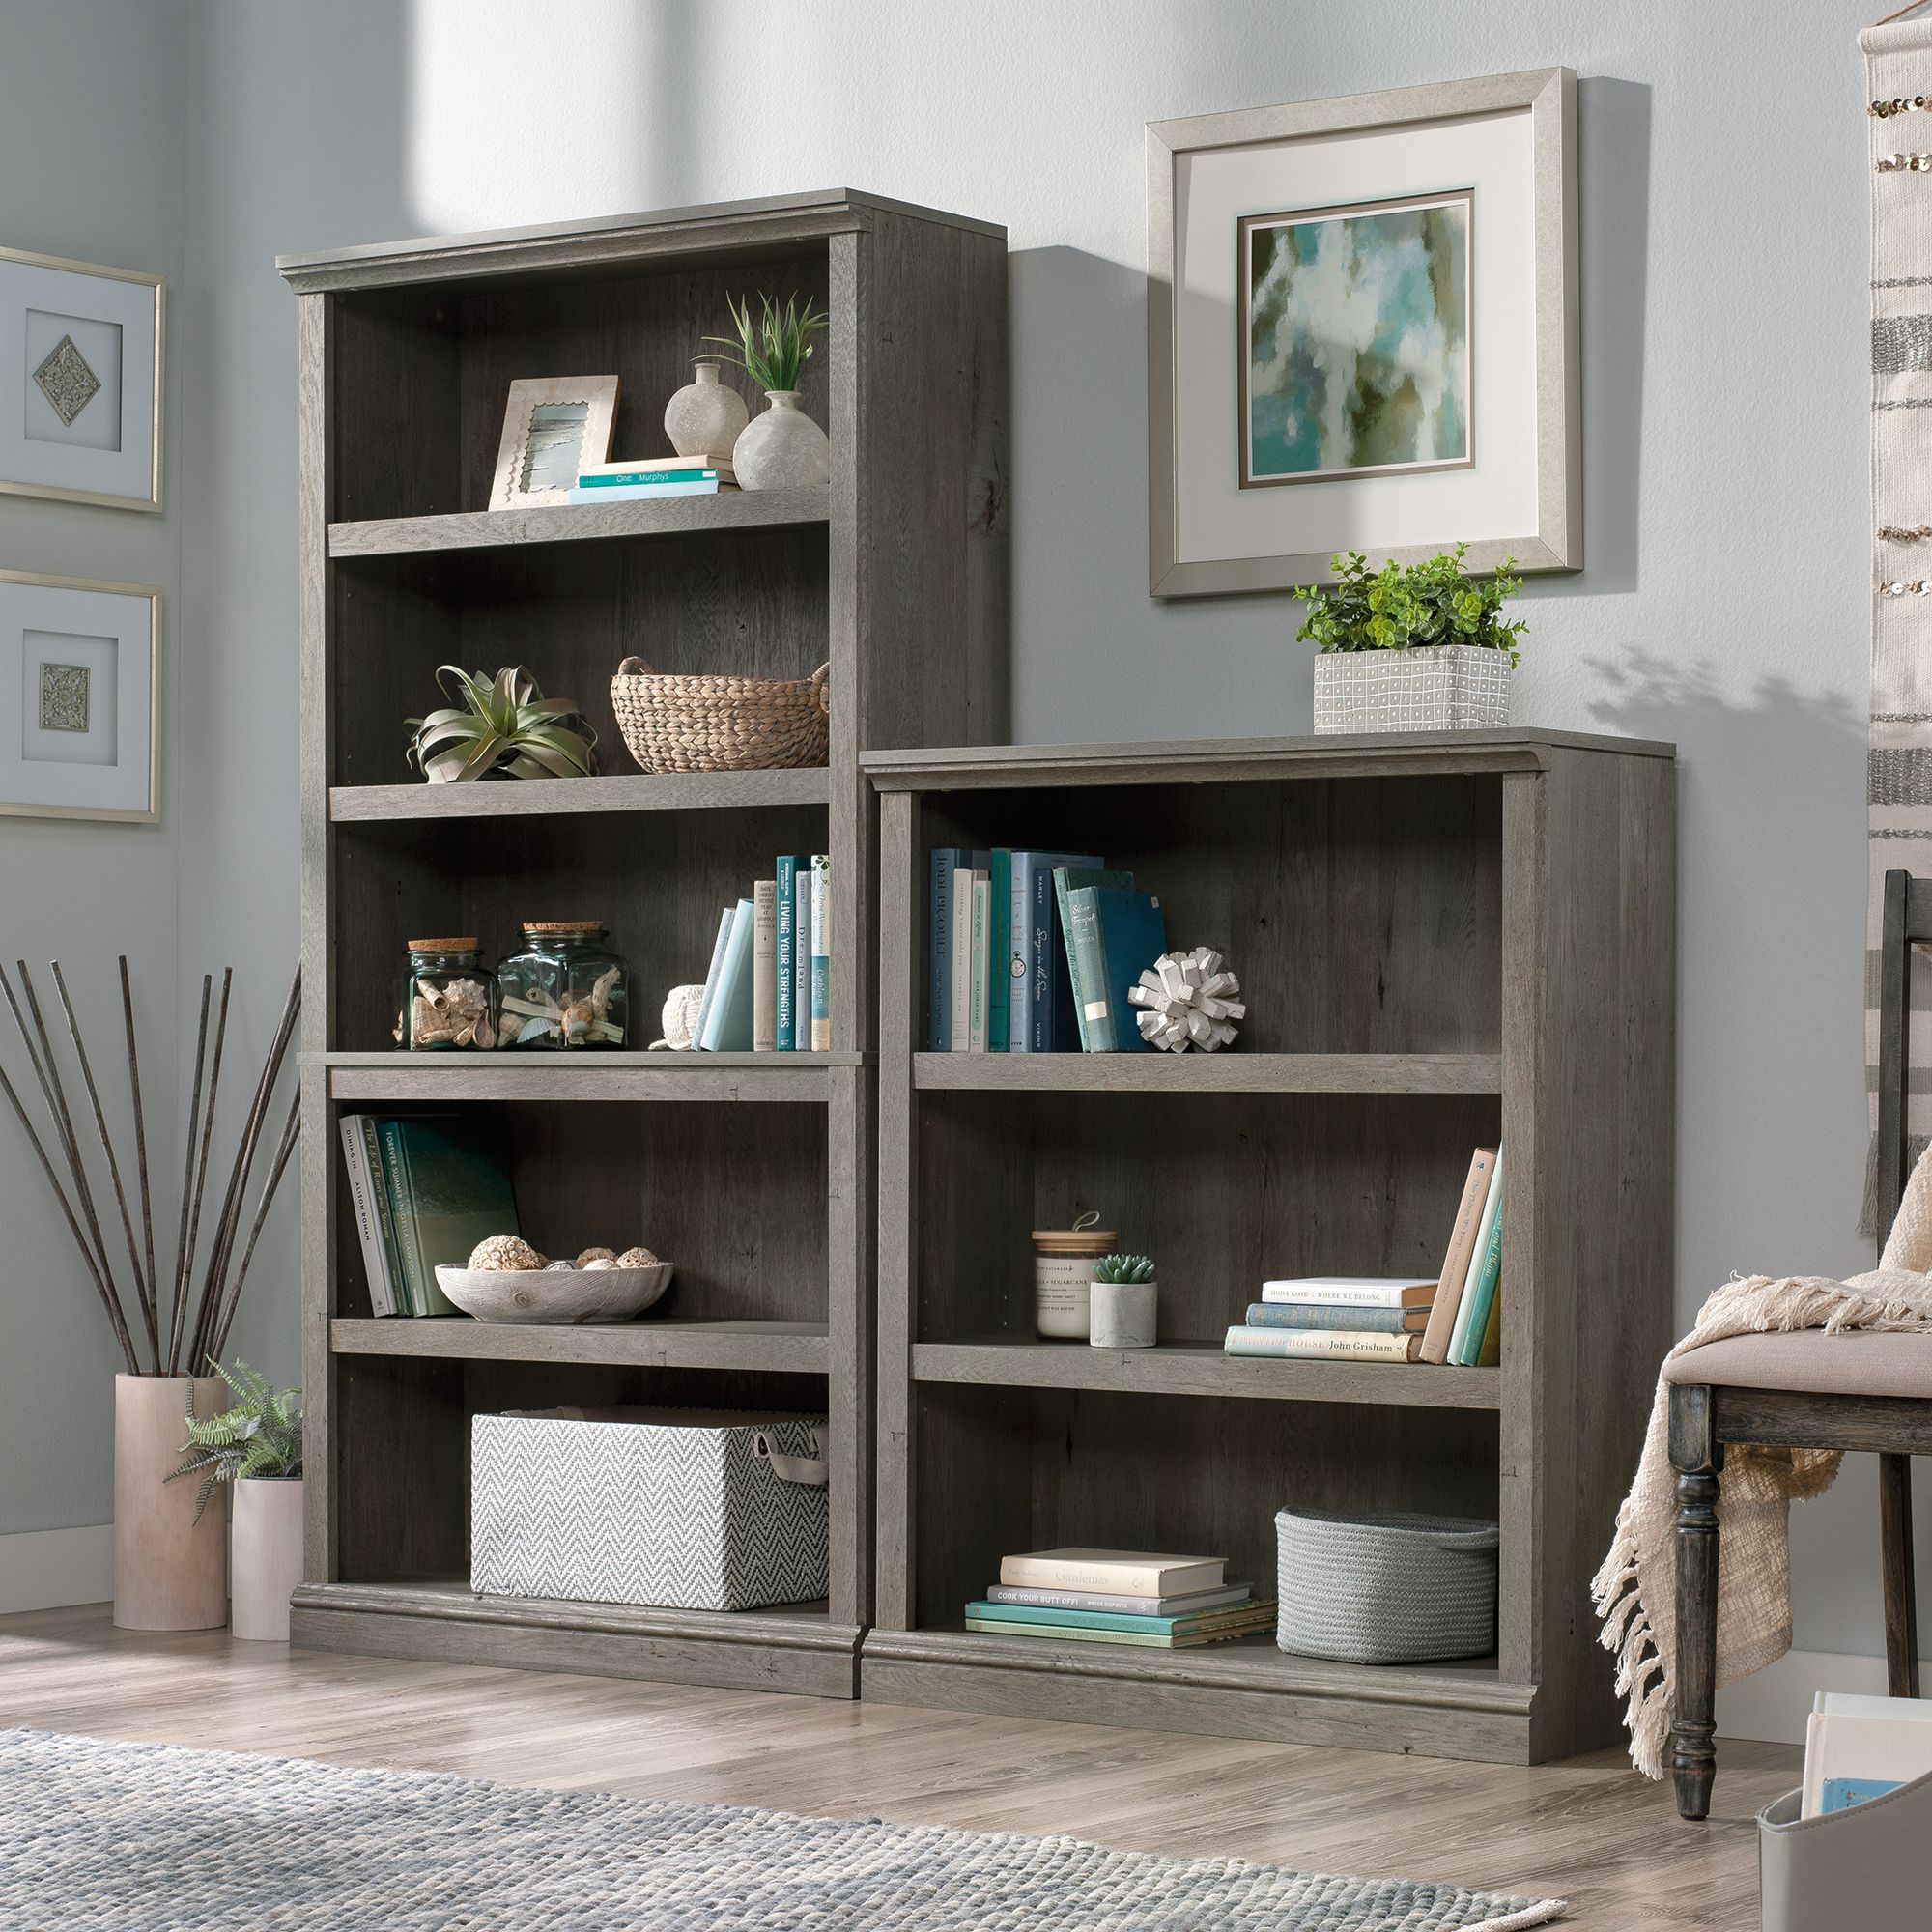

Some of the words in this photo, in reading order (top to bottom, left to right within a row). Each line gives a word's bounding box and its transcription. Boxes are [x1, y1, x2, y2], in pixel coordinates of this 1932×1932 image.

[616, 472, 632, 483] One
[639, 472, 669, 483] Murphys
[936, 857, 948, 889] JODI
[780, 900, 791, 934] LIVING
[935, 895, 946, 957] PICOULT
[780, 938, 791, 965] YOUR
[1037, 965, 1048, 978] the
[780, 968, 791, 1028] STRENGTHS
[365, 1127, 374, 1141] The
[346, 1129, 355, 1158] DINING
[353, 1160, 357, 1169] IN
[369, 1145, 378, 1158] Life
[386, 1131, 397, 1166] FOREVER
[391, 1166, 403, 1199] SUMMER
[355, 1181, 365, 1211] ALISON
[361, 1212, 371, 1241] ROMAN
[398, 1203, 409, 1238] NIGELLA
[404, 1240, 415, 1279] LAWSON
[1492, 1232, 1501, 1251] and
[1486, 1252, 1498, 1278] Plains
[1354, 1293, 1381, 1301] BELONG
[1288, 1338, 1324, 1349] HOUSE
[1328, 1340, 1350, 1350] John
[1352, 1341, 1393, 1352] Grisham
[1055, 1567, 1110, 1585] Gardenias
[997, 1591, 1017, 1601] COOK
[1019, 1593, 1038, 1603] YOUR
[1040, 1595, 1060, 1604] BUTT
[1061, 1597, 1079, 1606] OFF!
